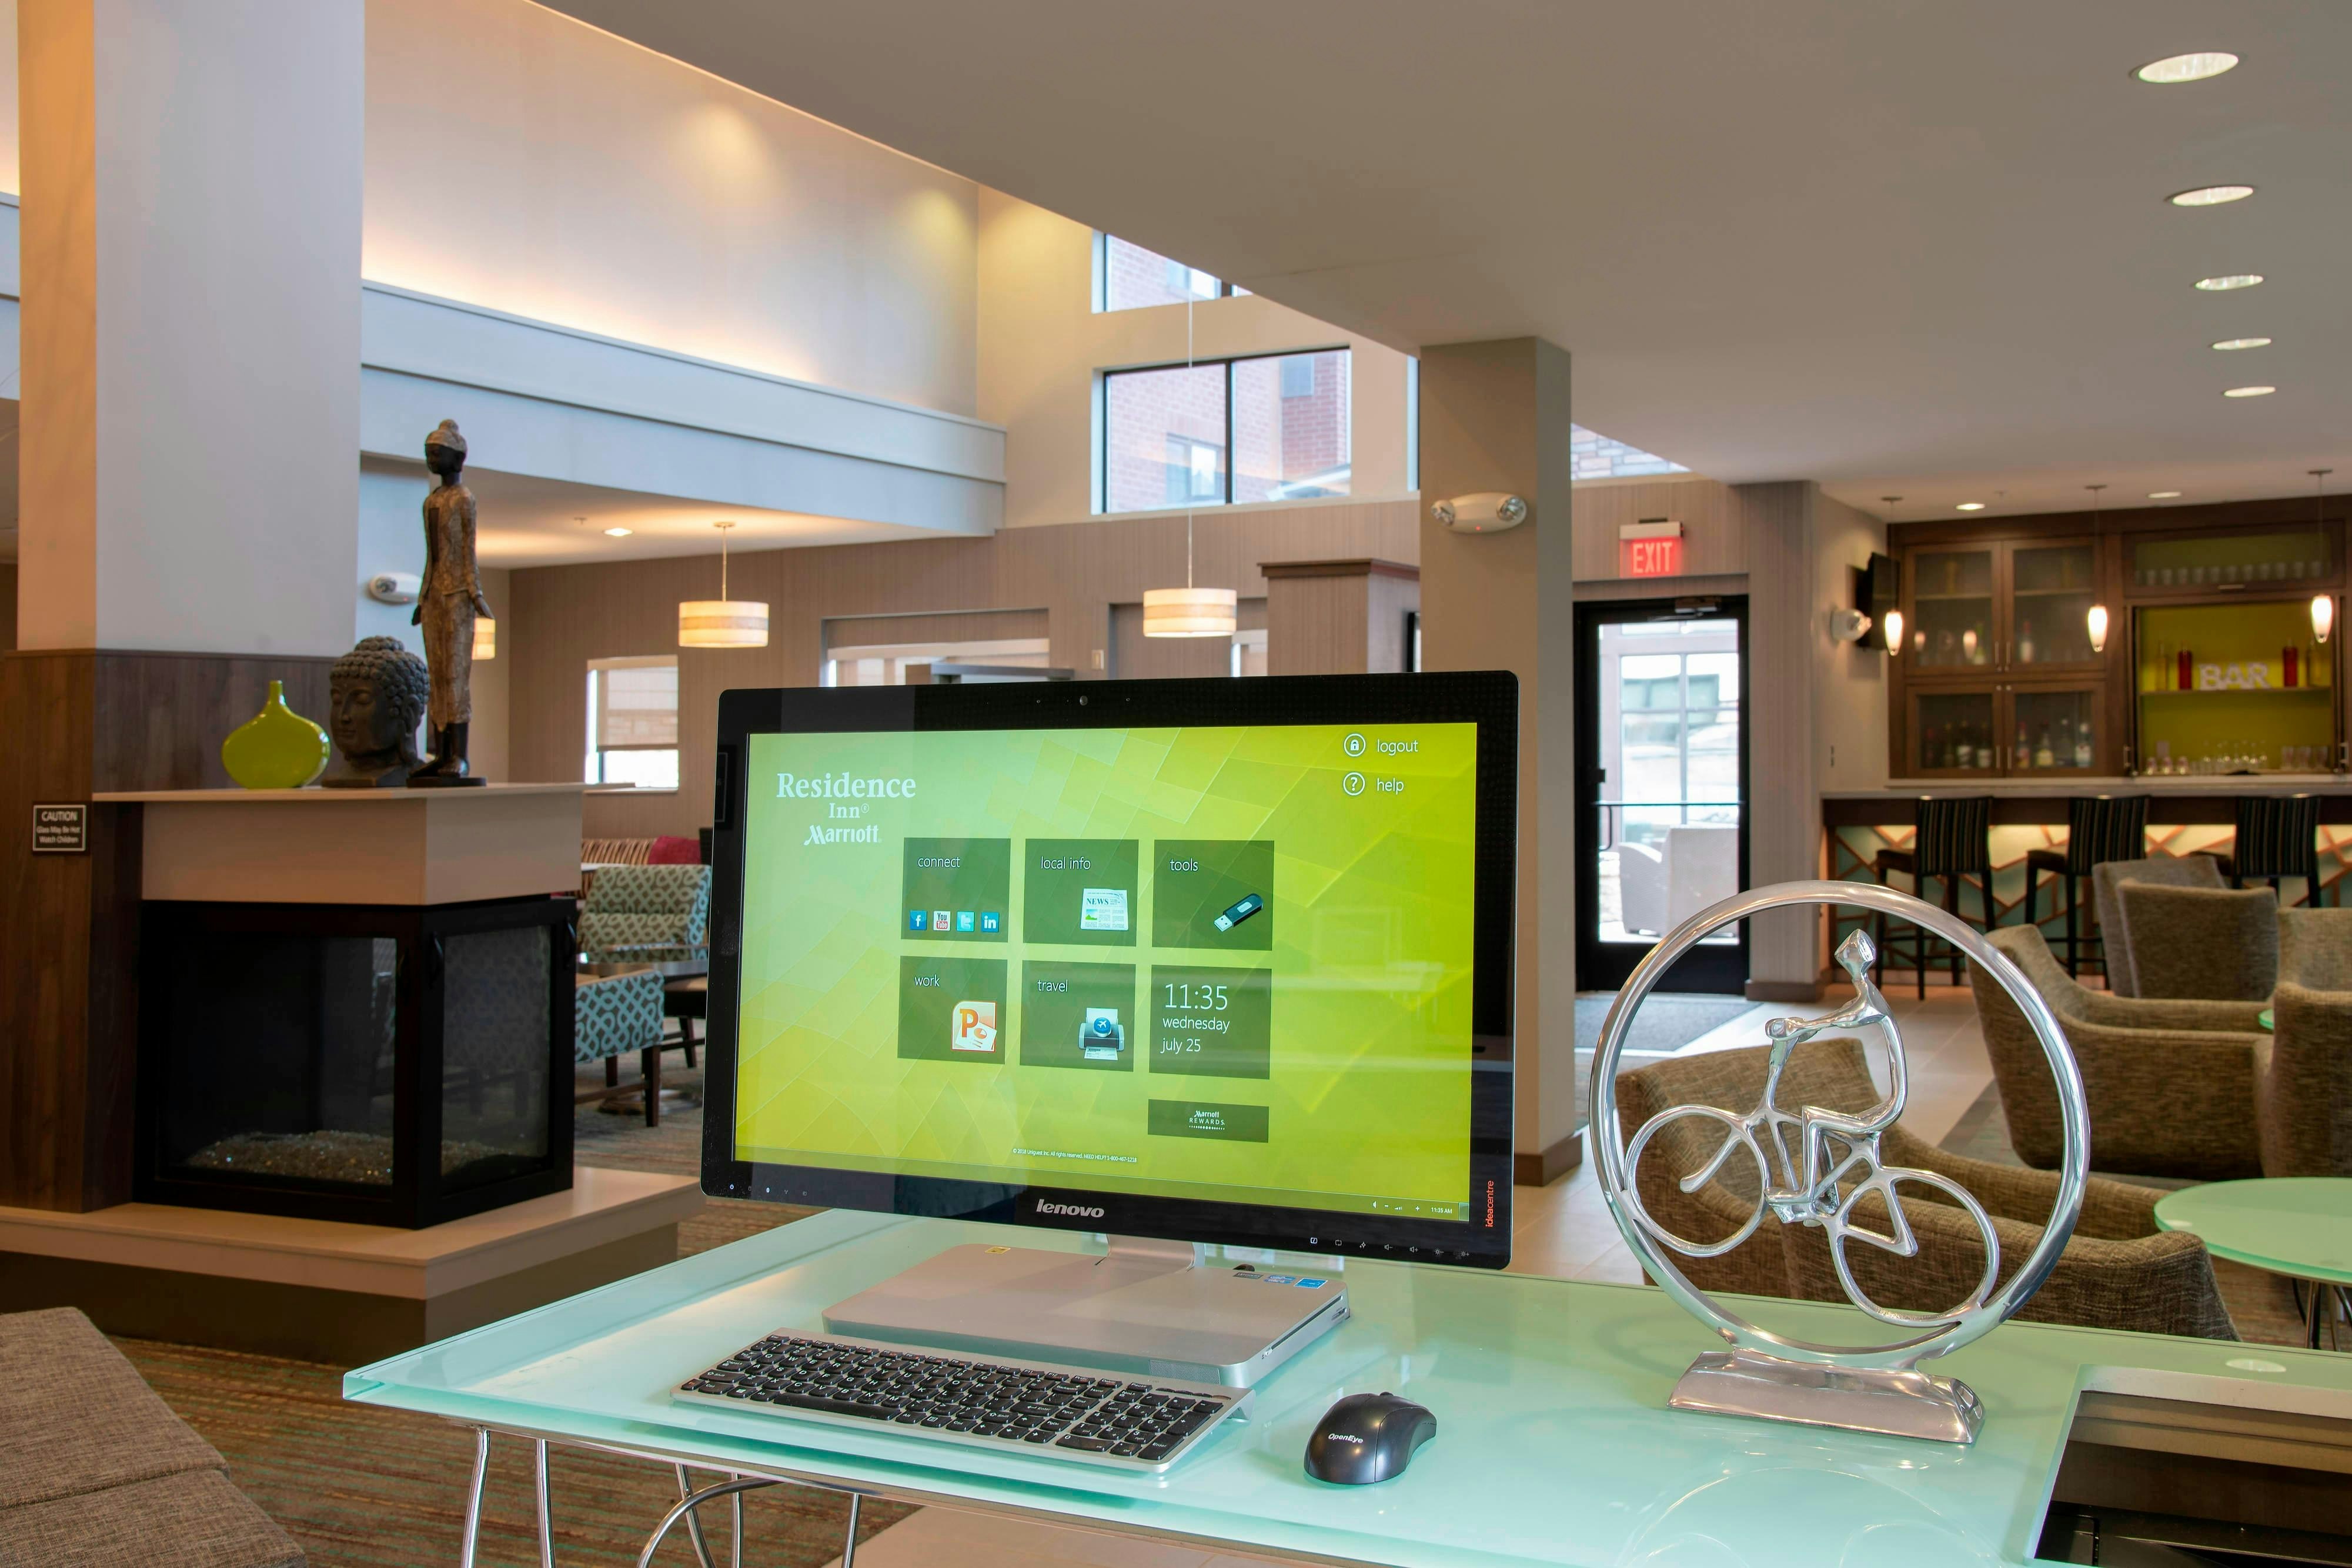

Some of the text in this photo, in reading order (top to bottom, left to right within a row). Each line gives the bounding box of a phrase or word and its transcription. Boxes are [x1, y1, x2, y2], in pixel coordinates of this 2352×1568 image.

[1633, 542, 1673, 573] EXIT
[2199, 662, 2272, 691] BAR
[1377, 739, 1418, 755] logout
[777, 772, 917, 798] Residence
[1377, 778, 1404, 795] help
[42, 811, 78, 821] CAUTION
[804, 825, 880, 845] Marriott
[918, 856, 960, 868] connect
[1041, 856, 1091, 870] local info
[1170, 858, 1198, 872] tools
[984, 915, 997, 929] in
[914, 975, 940, 987] work
[1037, 979, 1068, 992] travel
[1165, 983, 1228, 1010] 11:35
[1162, 1016, 1230, 1034] wednesday
[1160, 1037, 1201, 1054] july 25
[1194, 1110, 1220, 1118] Marriott
[1036, 1199, 1105, 1218] lenovo
[1485, 1181, 1494, 1228] ideacentre
[1328, 1433, 1364, 1444] OpenEye
